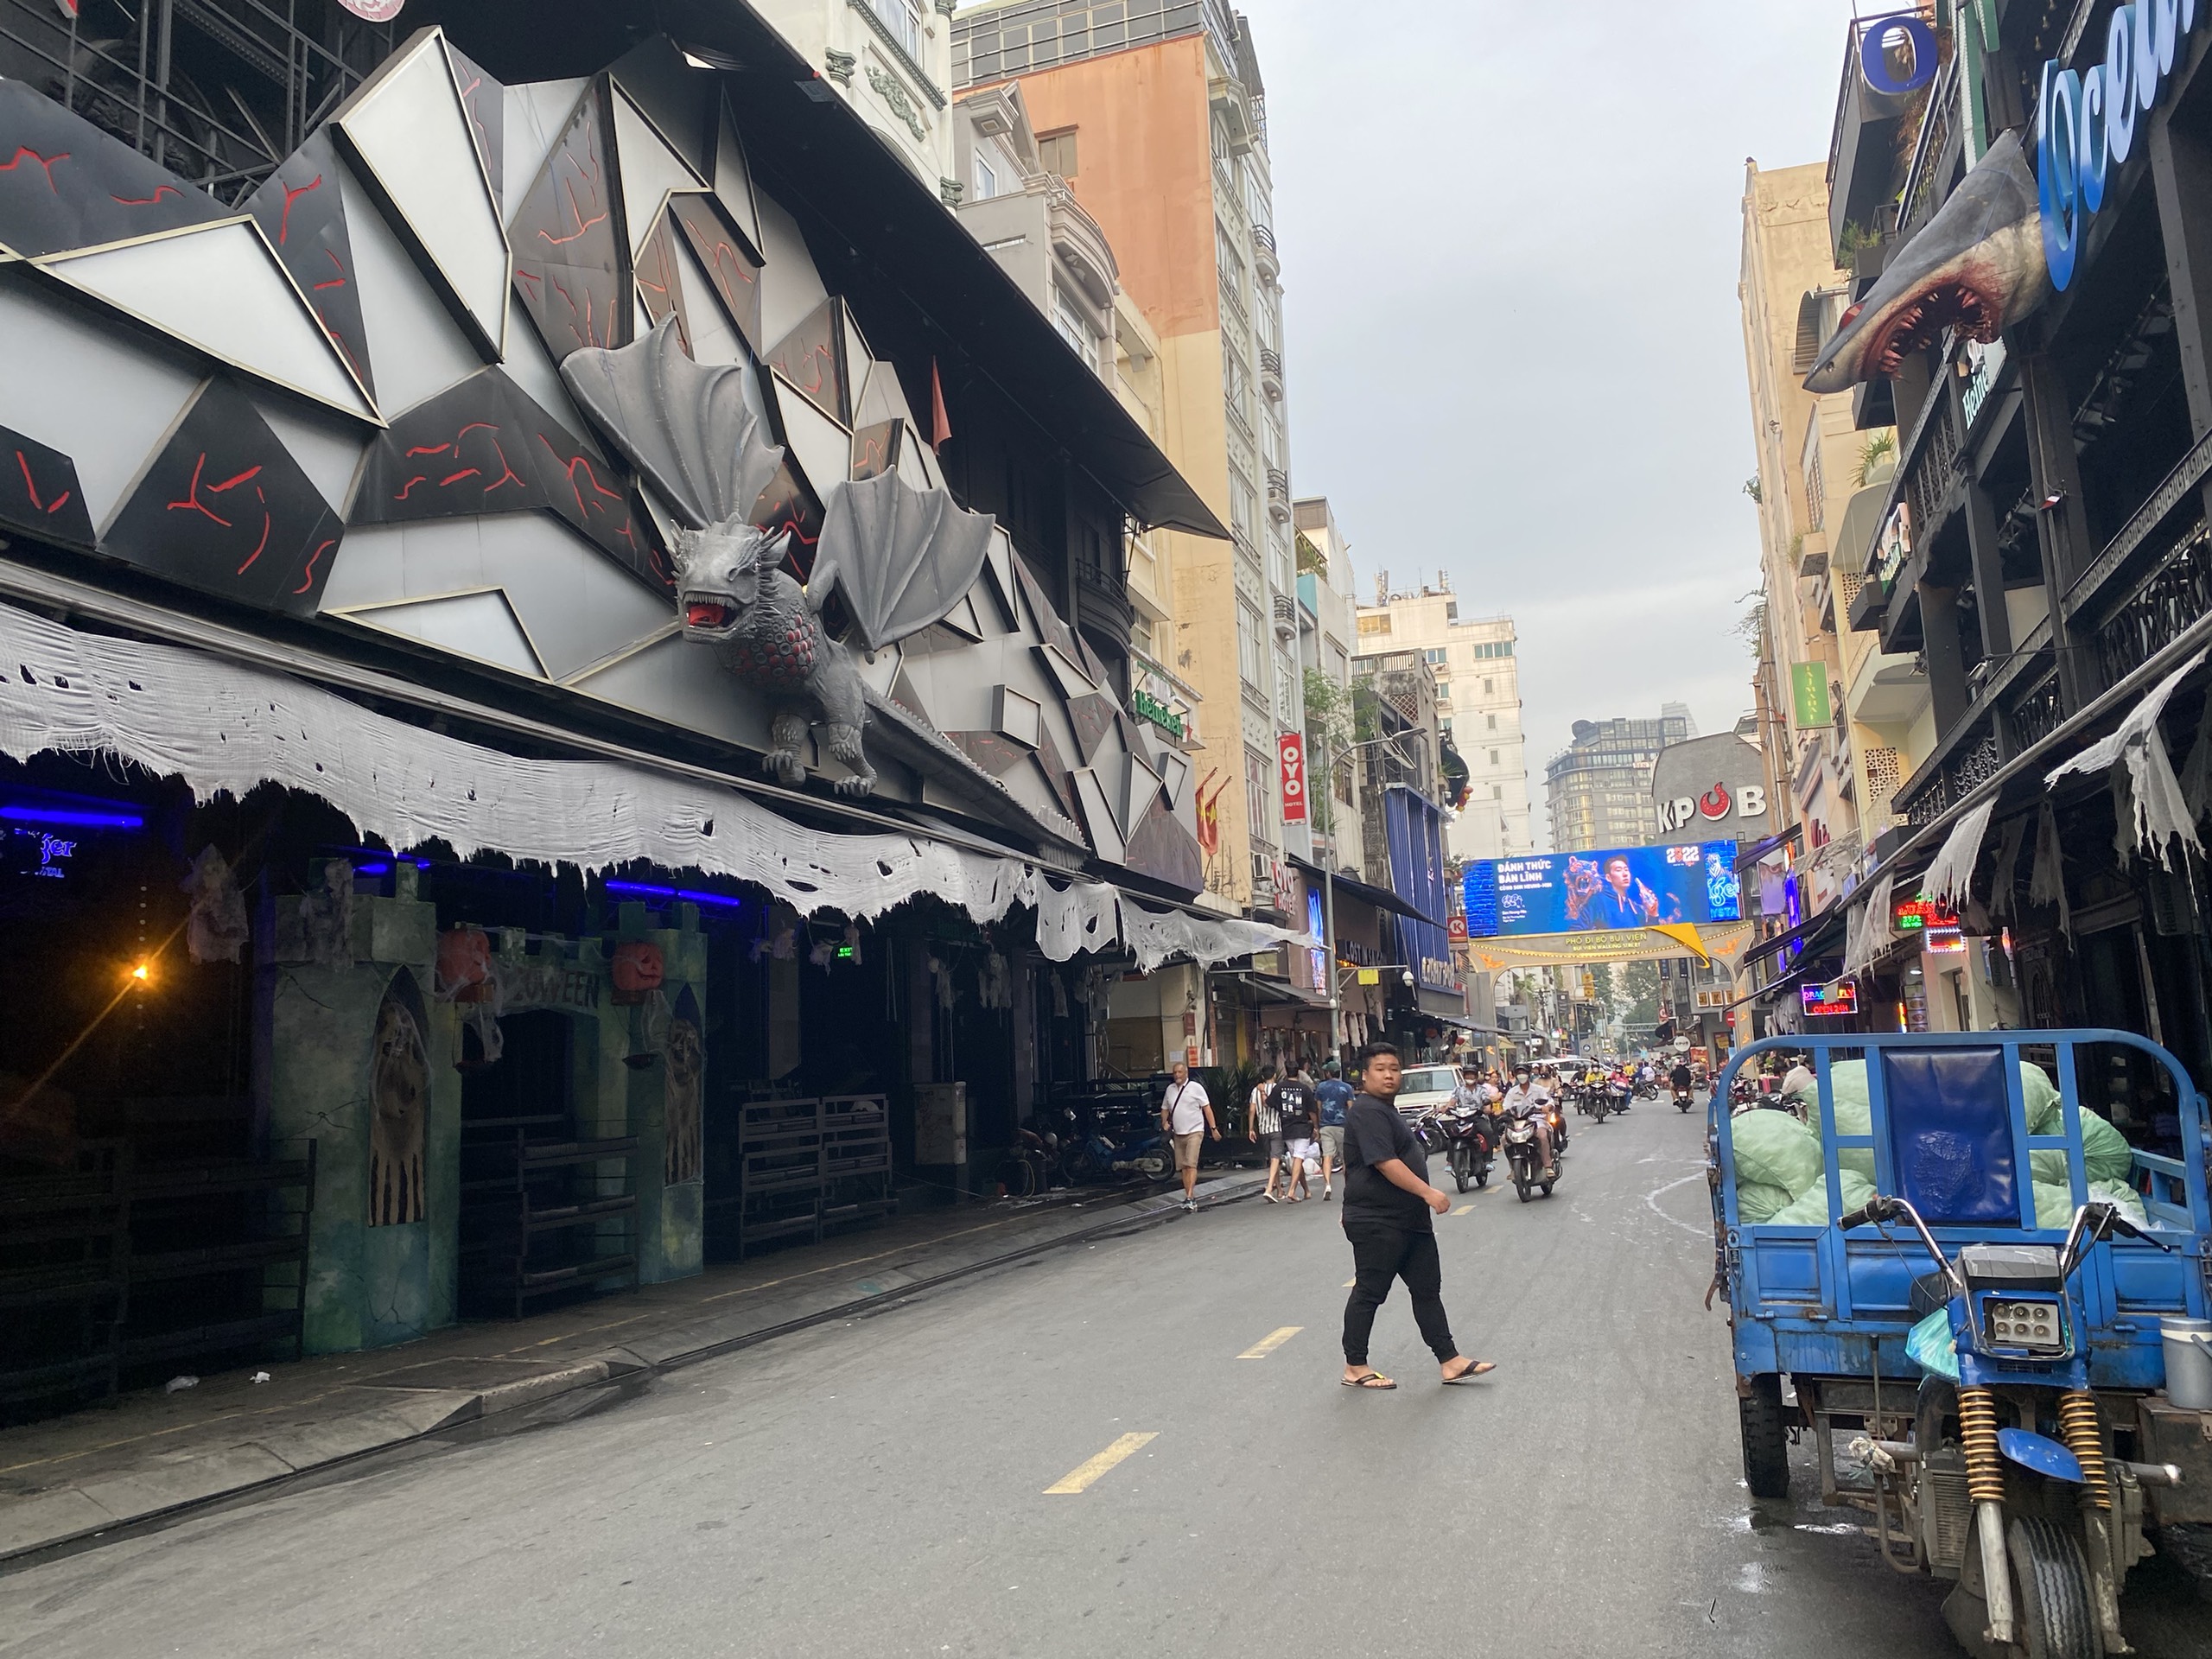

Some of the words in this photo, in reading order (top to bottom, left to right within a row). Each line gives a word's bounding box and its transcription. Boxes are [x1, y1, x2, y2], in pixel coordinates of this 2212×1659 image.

[1282, 747, 1301, 796] OYO
[1497, 861, 1524, 873] ĐÁNH
[1525, 859, 1552, 870] THỨC
[1565, 936, 1582, 945] PHỐ
[1626, 931, 1647, 942] VIỆN
[1344, 939, 1361, 964] LOST
[1282, 1103, 1294, 1113] ER
